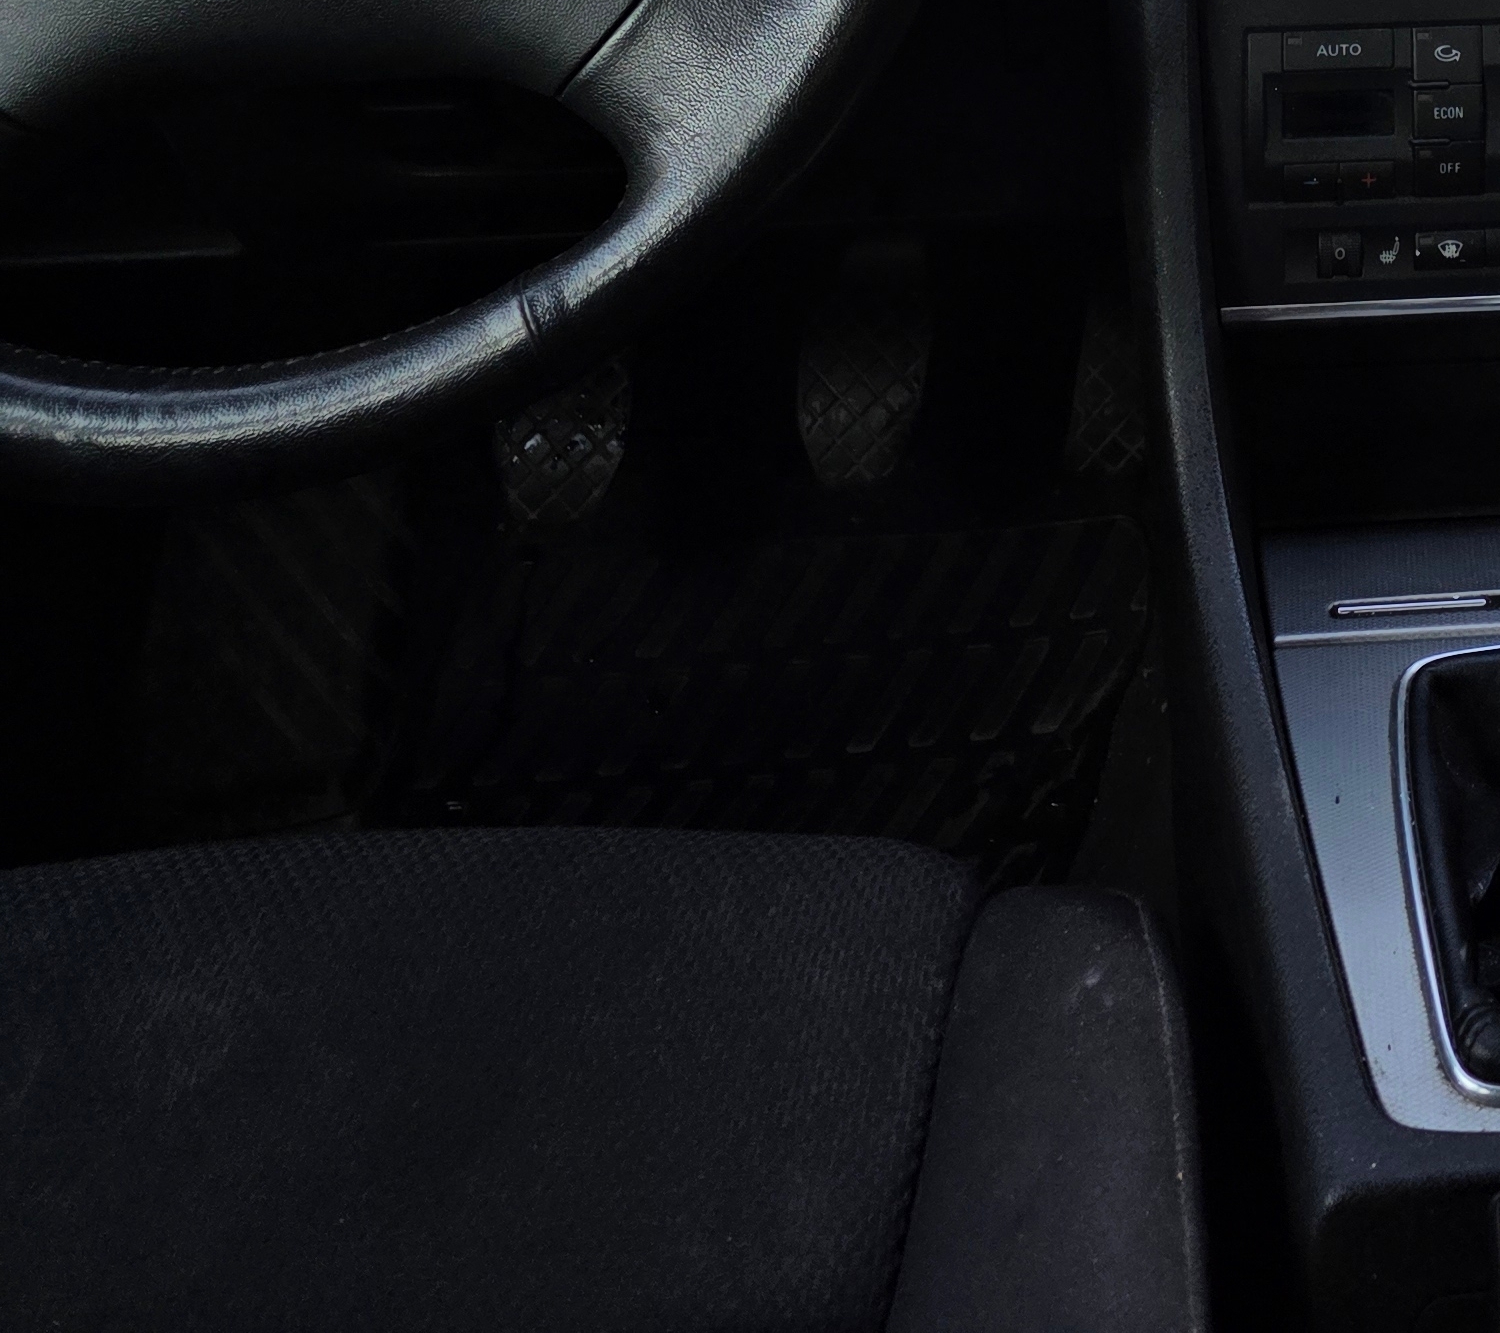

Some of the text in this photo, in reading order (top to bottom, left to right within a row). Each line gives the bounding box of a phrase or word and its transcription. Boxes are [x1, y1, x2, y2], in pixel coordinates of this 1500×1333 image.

[1316, 43, 1362, 57] AUTO
[1433, 107, 1464, 119] ECON
[1439, 162, 1461, 174] OFF
